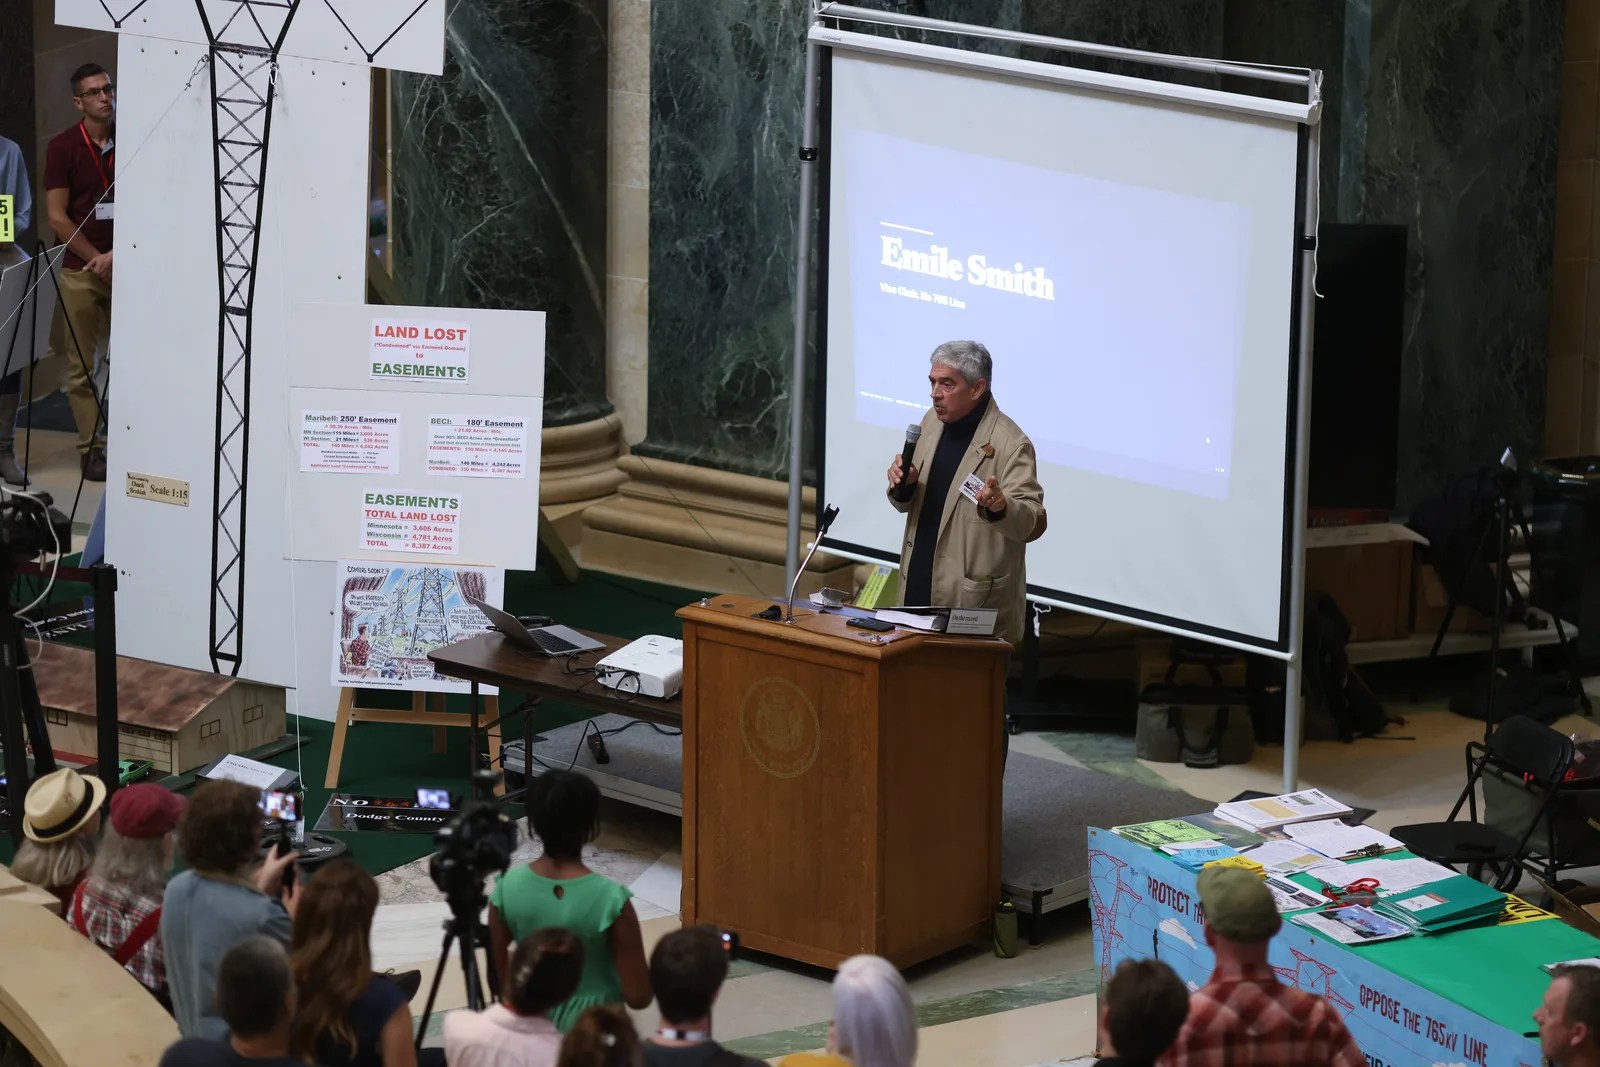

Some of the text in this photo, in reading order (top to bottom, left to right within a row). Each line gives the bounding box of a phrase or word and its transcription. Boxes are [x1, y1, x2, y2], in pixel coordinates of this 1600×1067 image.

[880, 235, 1055, 300] Emile Smith
[375, 325, 467, 340] LAND LOST
[373, 363, 466, 378] EASEMENTS
[150, 484, 170, 496] Scale
[172, 489, 187, 499] 1:15
[365, 493, 458, 509] EASEMENTS
[365, 510, 457, 522] TOTAL LAND LOST
[367, 522, 402, 530] Minnesota
[332, 798, 368, 806] NO
[346, 812, 390, 820] Dodge
[1148, 875, 1190, 916] PROTECT
[1359, 984, 1400, 1024] OPPOSE
[1403, 1008, 1421, 1035] THE
[1464, 1034, 1488, 1067] LINE
